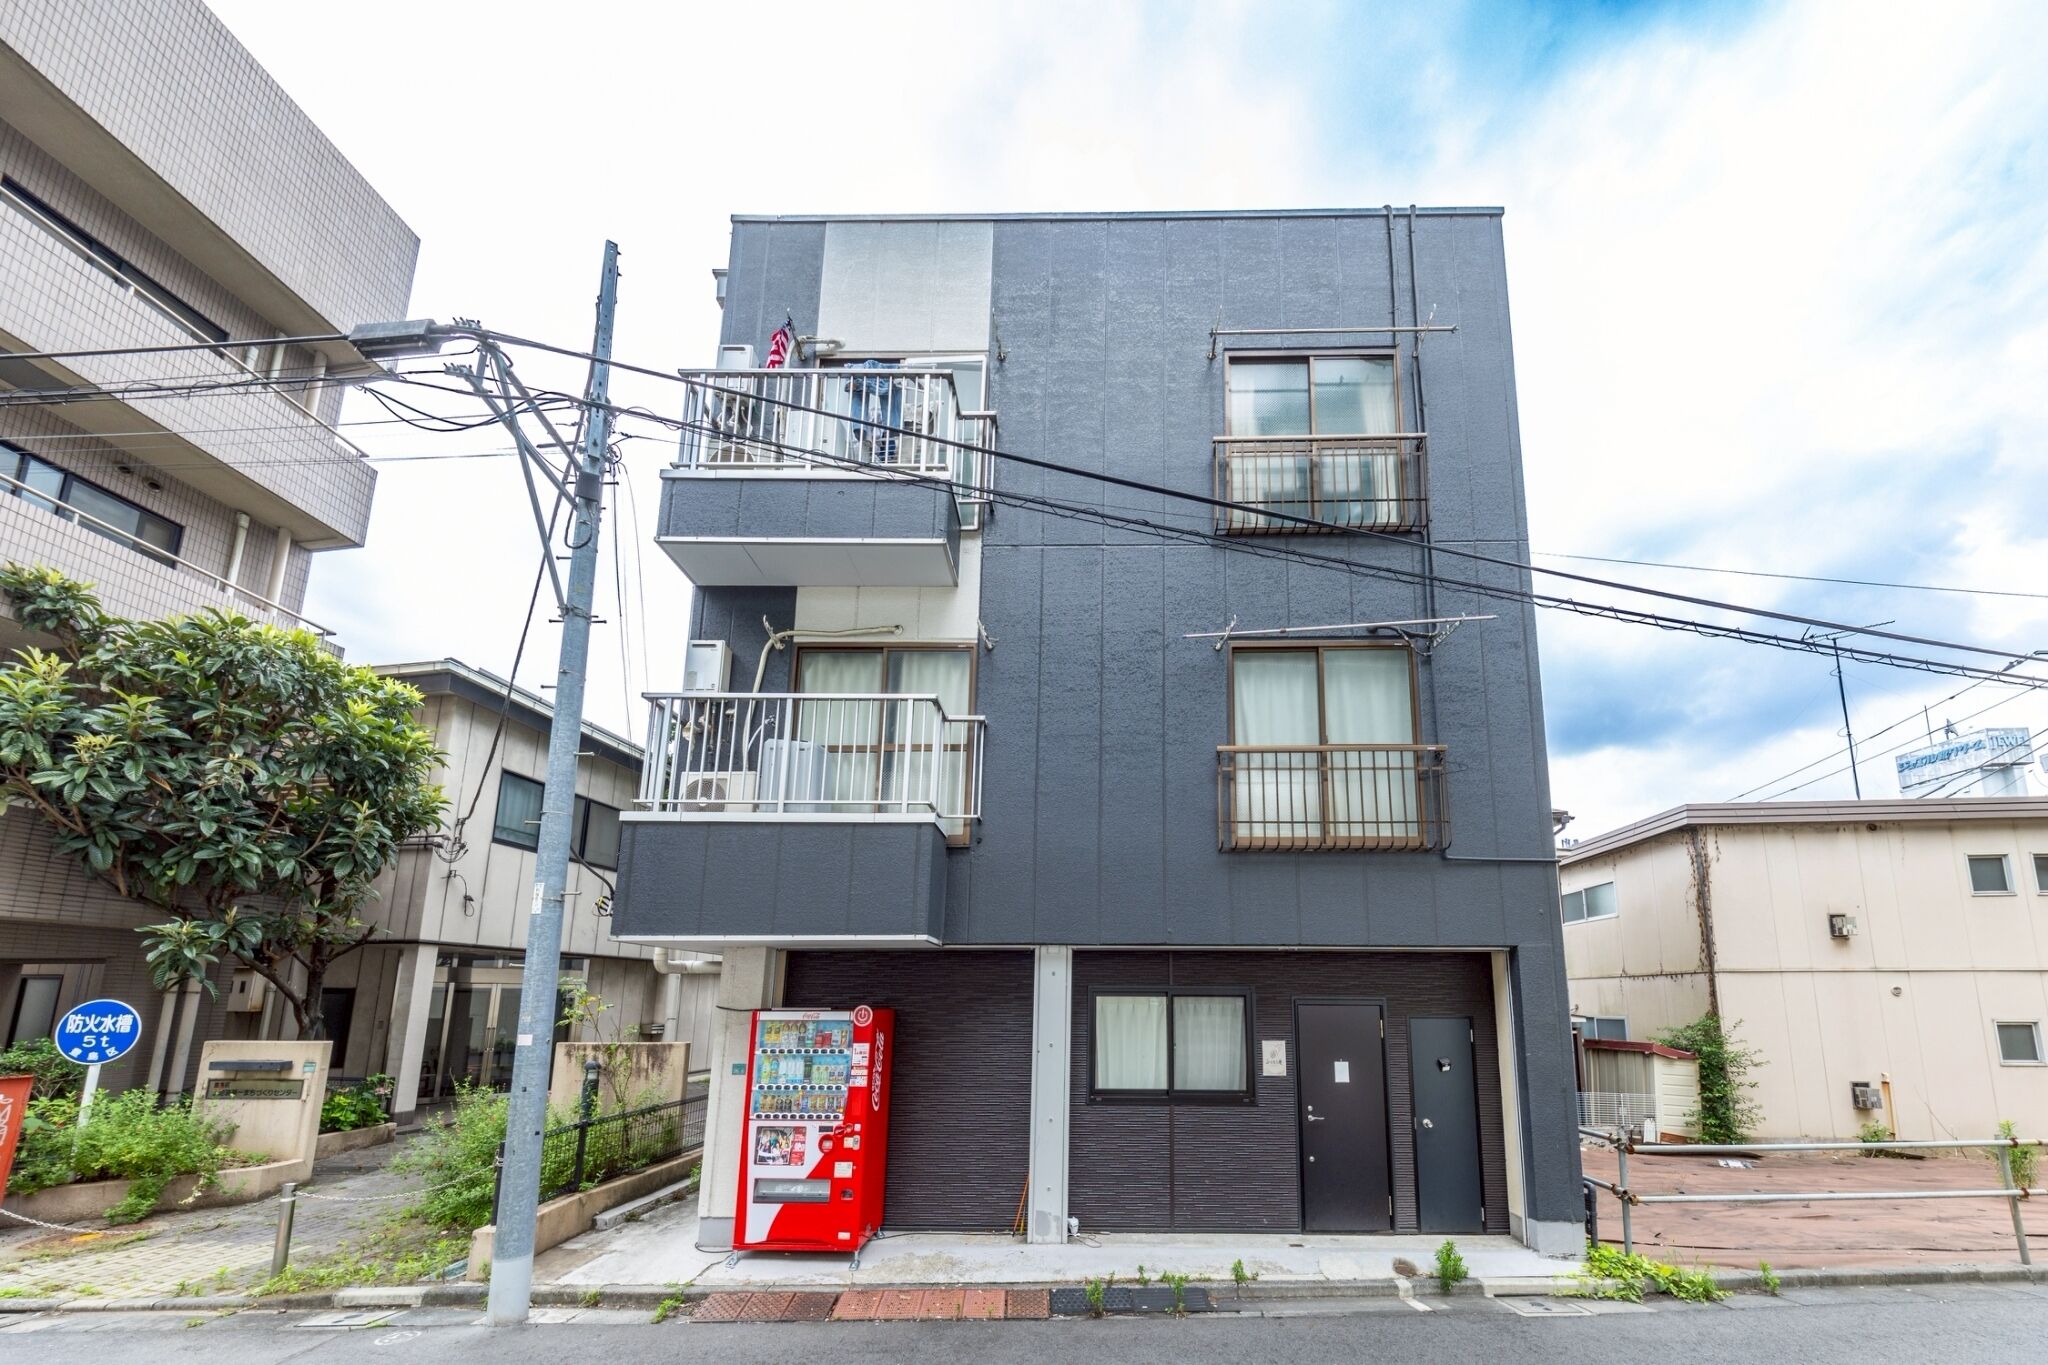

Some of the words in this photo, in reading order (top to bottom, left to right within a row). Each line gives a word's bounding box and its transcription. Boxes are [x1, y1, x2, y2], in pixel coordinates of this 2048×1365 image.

[65, 1013, 134, 1034] 防火水槽
[871, 1027, 885, 1112] Coca-Cola
